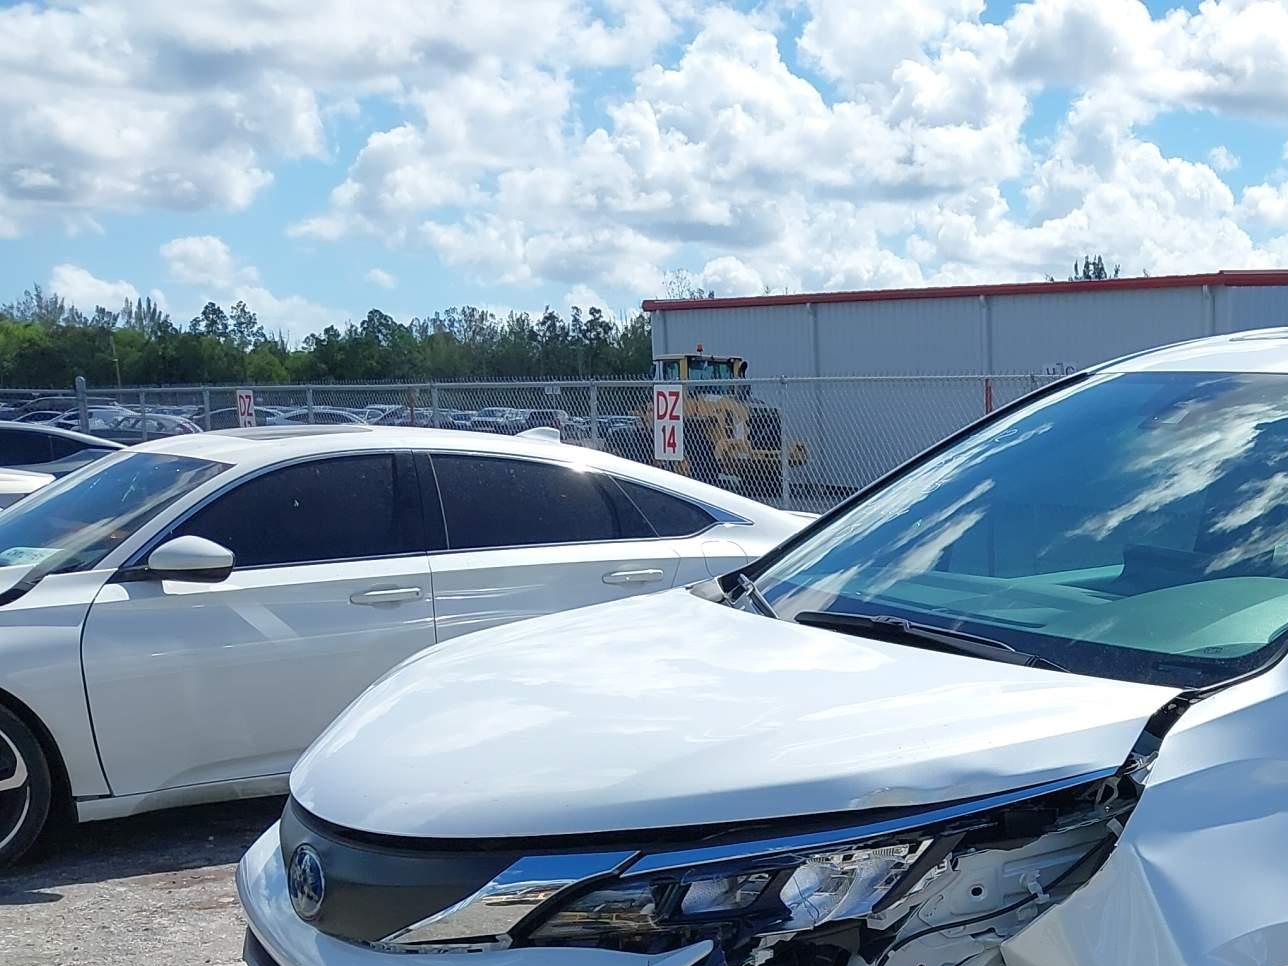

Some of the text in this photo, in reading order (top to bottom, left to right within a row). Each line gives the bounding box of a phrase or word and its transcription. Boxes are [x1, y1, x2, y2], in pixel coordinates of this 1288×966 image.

[239, 395, 253, 416] DZ
[657, 391, 680, 420] DZ
[662, 425, 677, 454] 14
